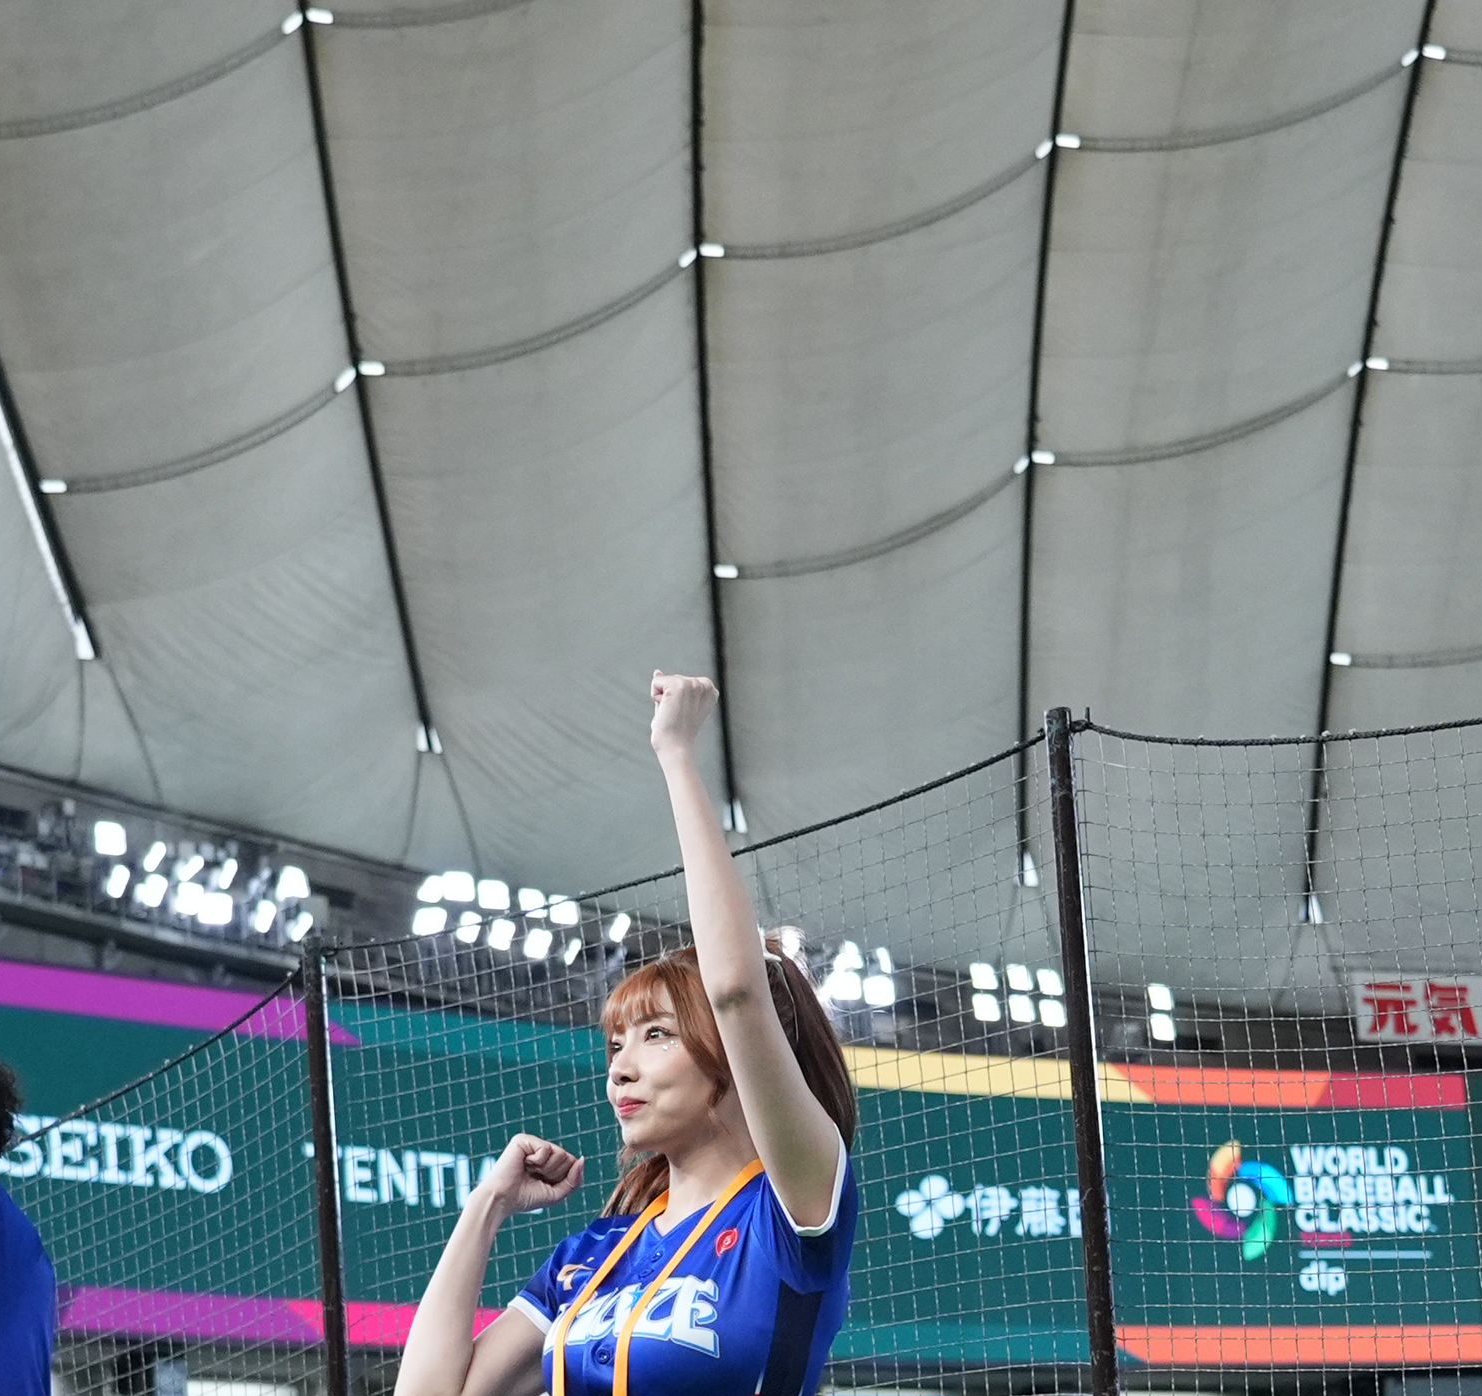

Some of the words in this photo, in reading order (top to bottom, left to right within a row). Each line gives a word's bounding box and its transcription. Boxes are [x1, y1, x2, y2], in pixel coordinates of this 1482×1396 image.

[1290, 1145, 1409, 1175] WORLD
[301, 1142, 499, 1210] ENTI
[1293, 1175, 1451, 1204] BASEBALL
[1294, 1203, 1432, 1233] CLASSIC
[1299, 1260, 1347, 1296] dip
